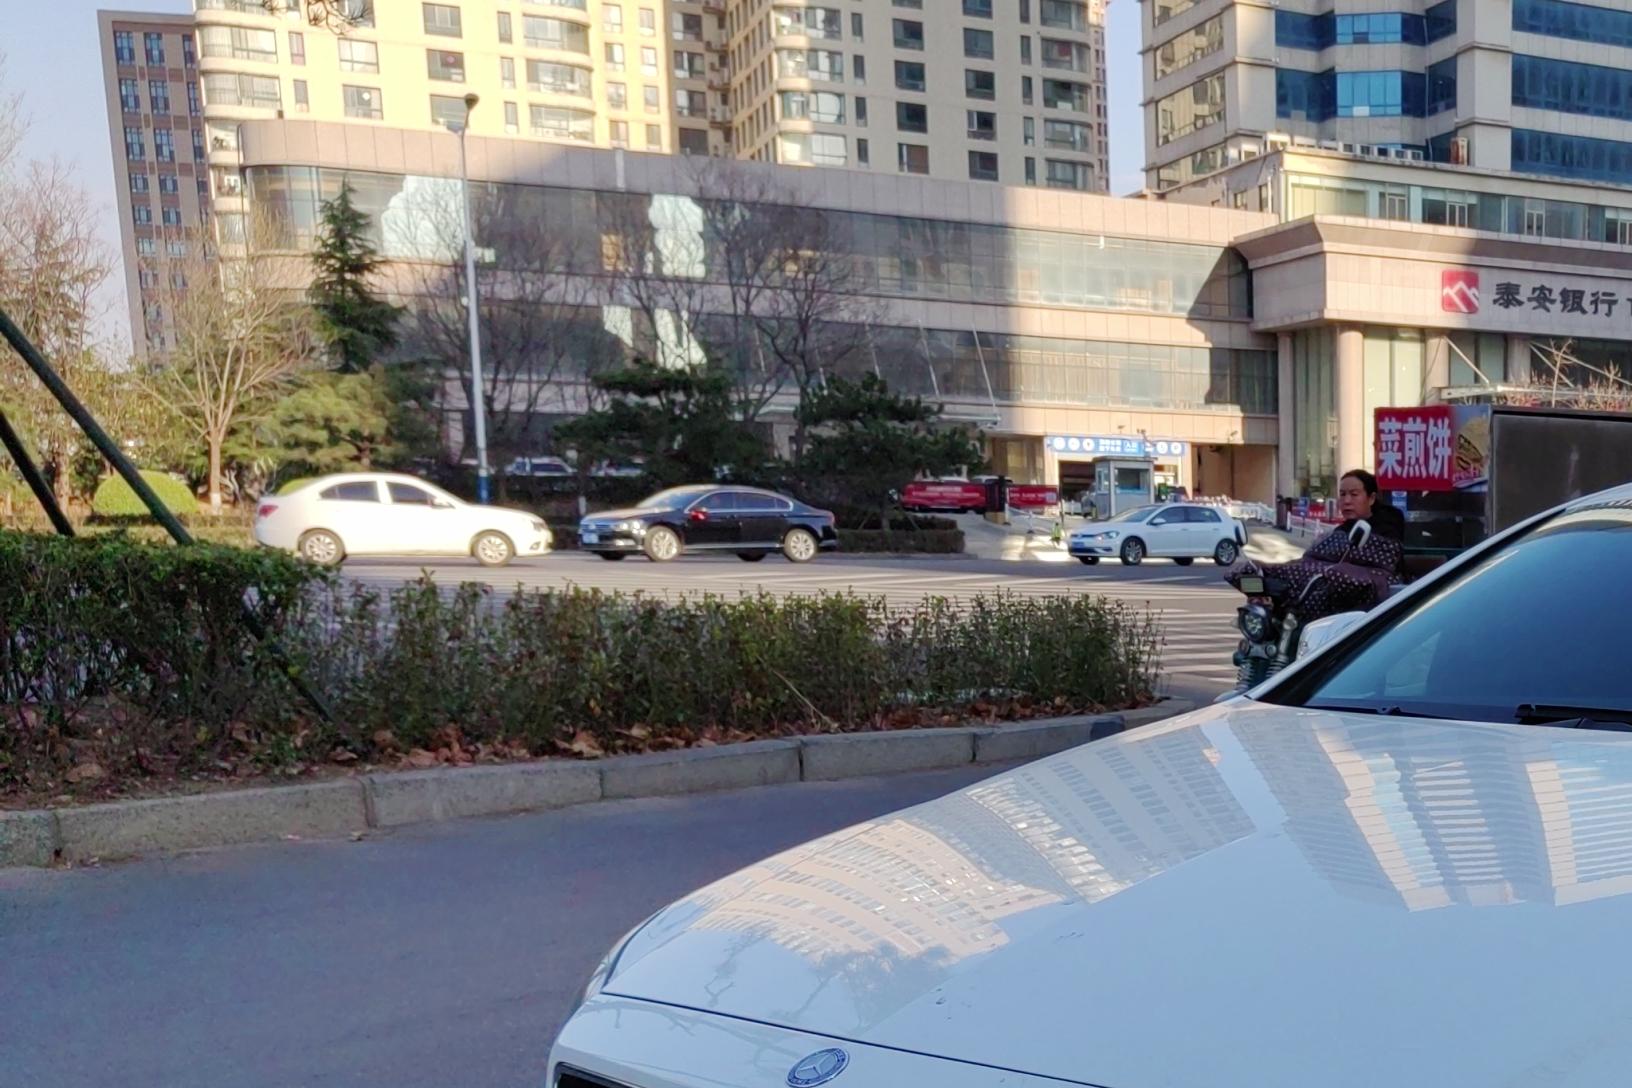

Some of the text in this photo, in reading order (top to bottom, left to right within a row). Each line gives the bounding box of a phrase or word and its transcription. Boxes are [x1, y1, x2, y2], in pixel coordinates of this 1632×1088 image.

[1492, 281, 1619, 318] 泰安银行
[1378, 416, 1452, 479] 菜煎饼
